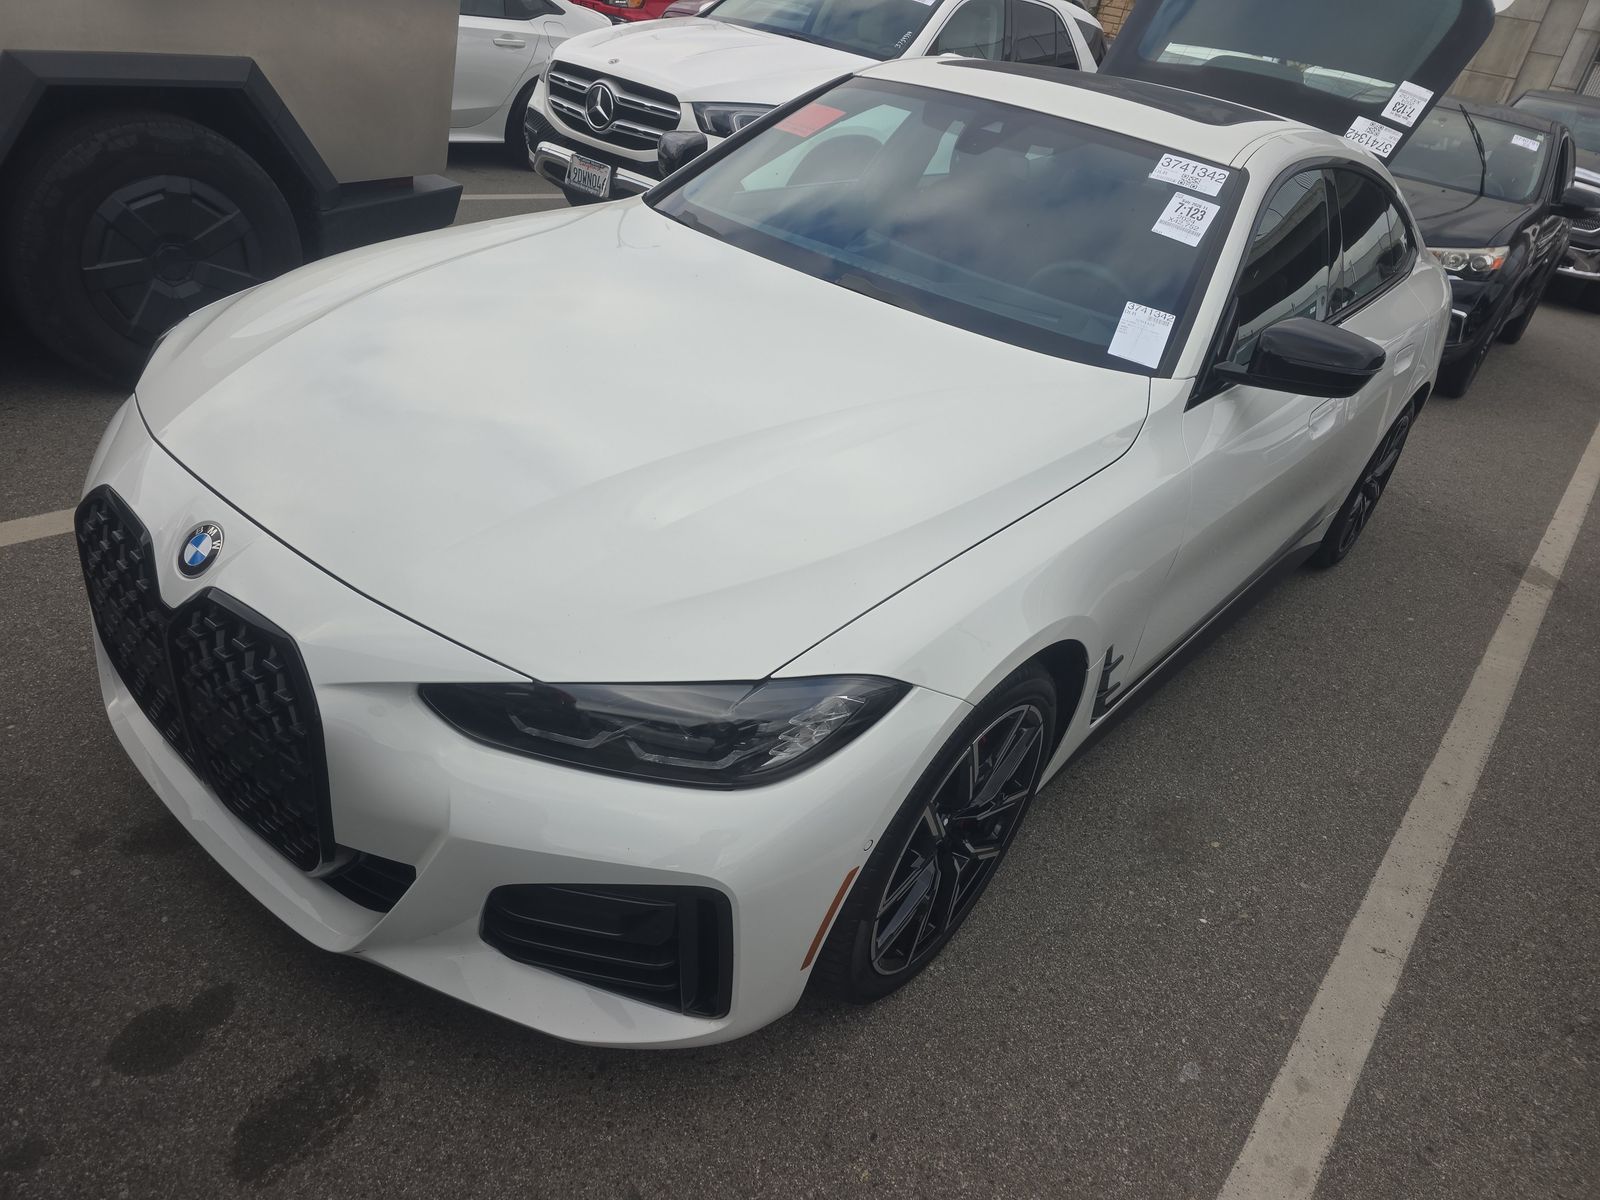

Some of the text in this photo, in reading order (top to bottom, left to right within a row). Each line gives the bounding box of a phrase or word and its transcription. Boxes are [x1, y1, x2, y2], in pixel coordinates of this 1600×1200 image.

[1345, 128, 1392, 154] 3741342
[1161, 157, 1227, 184] 3741342
[1128, 302, 1175, 323] 3741342
[196, 526, 221, 550] BMW
